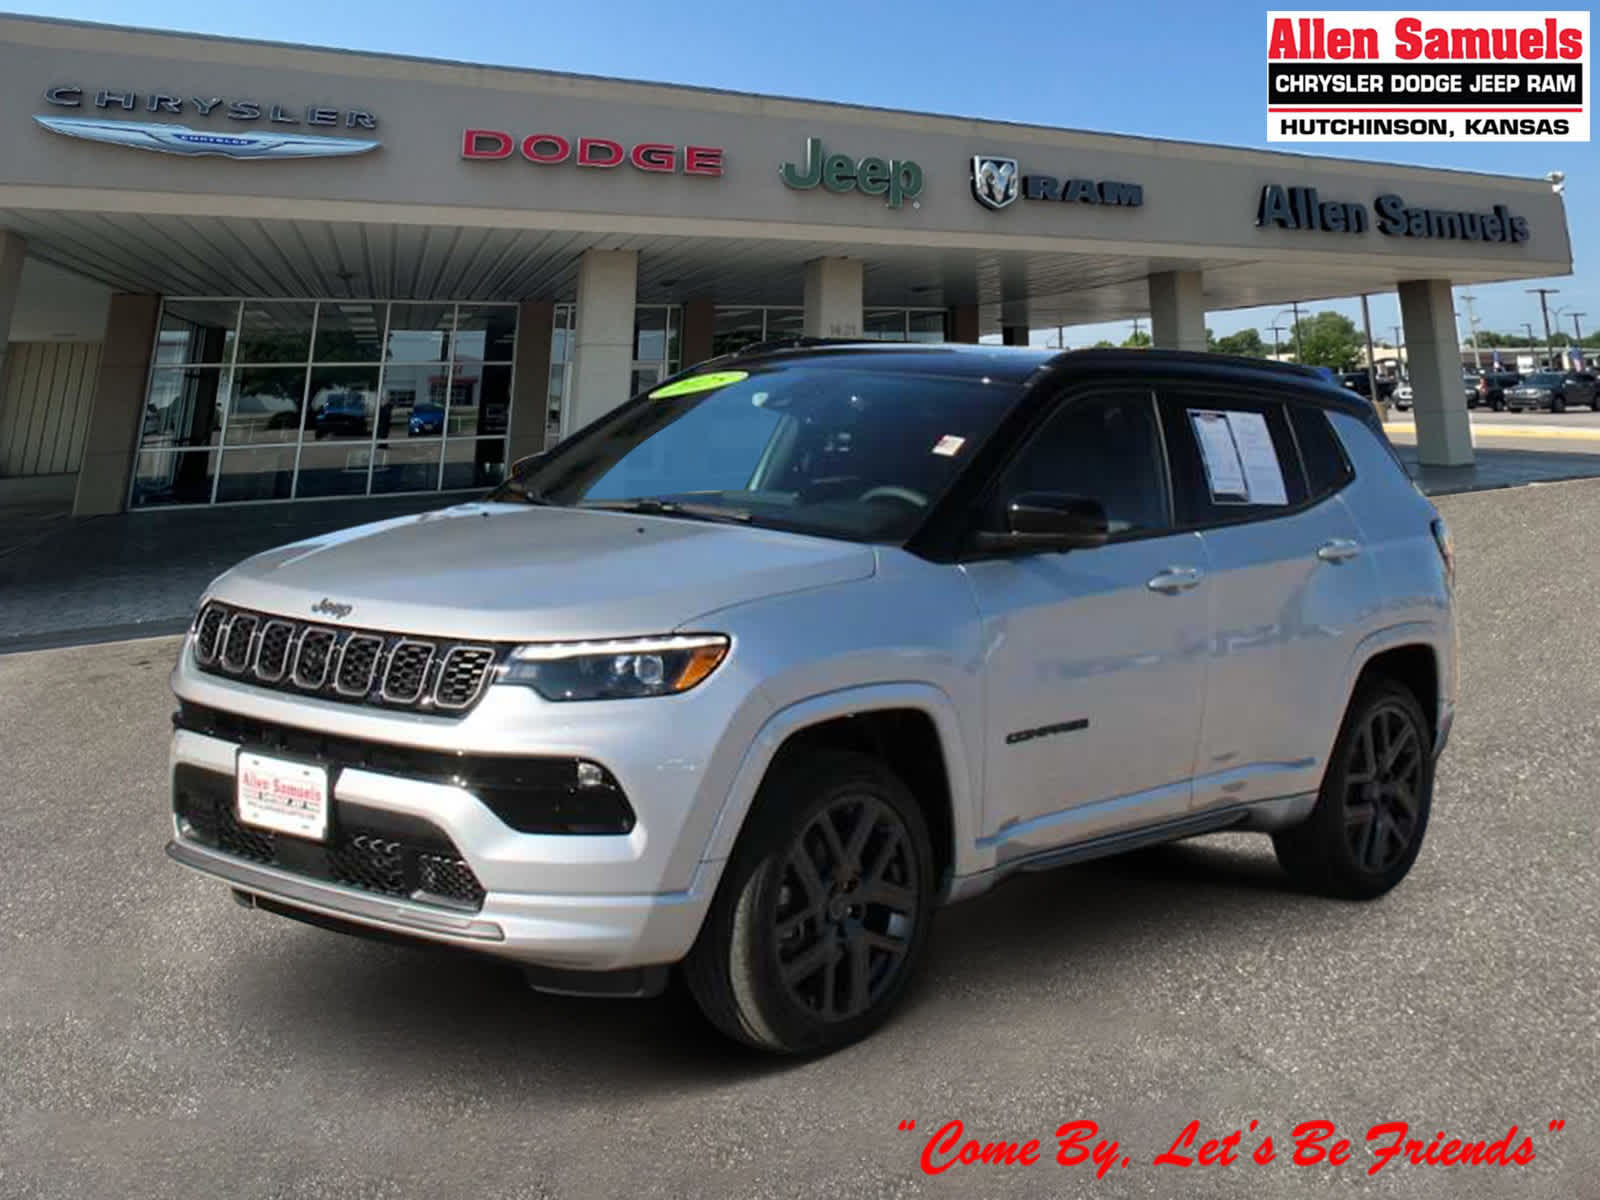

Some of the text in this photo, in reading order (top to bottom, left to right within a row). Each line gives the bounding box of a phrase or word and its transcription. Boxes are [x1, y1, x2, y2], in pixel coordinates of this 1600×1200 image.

[43, 87, 377, 130] CHRYSLER
[461, 128, 723, 177] DODGE
[779, 137, 924, 208] Jeep
[1022, 175, 1144, 208] RAM
[1256, 184, 1530, 243] Allen Samuels
